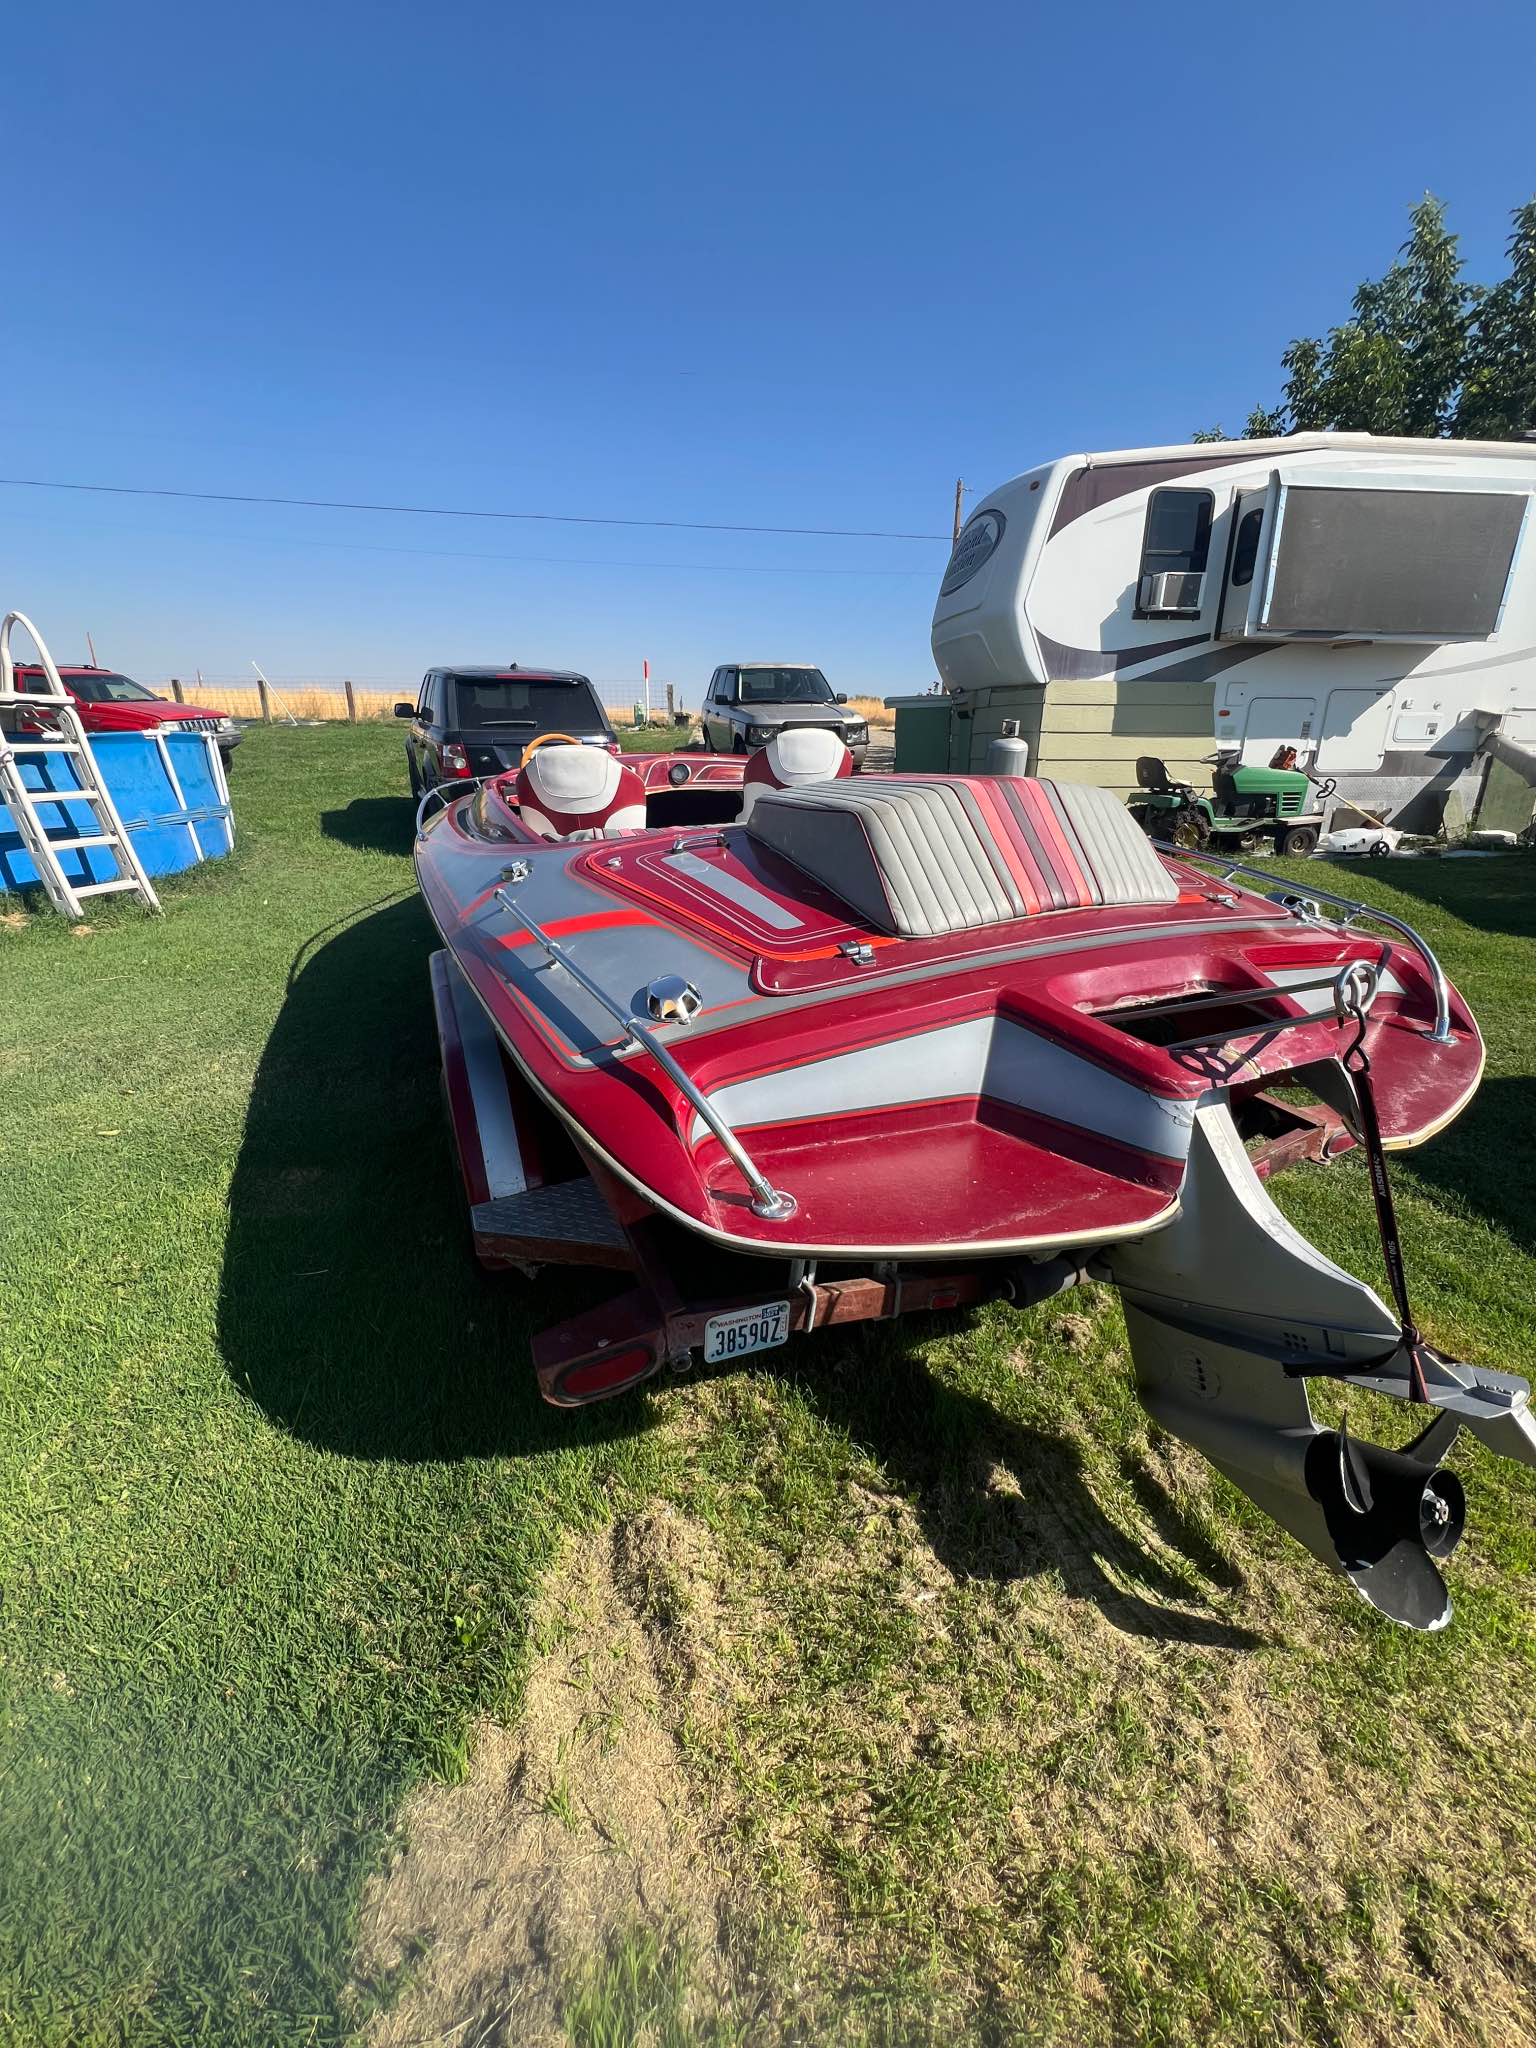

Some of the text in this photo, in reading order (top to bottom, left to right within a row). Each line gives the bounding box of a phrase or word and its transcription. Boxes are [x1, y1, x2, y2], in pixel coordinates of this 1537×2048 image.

[1374, 1164, 1387, 1199] HUSKY
[715, 1317, 781, 1356] 3859QZ
[717, 1312, 762, 1328] WASHINGTON
